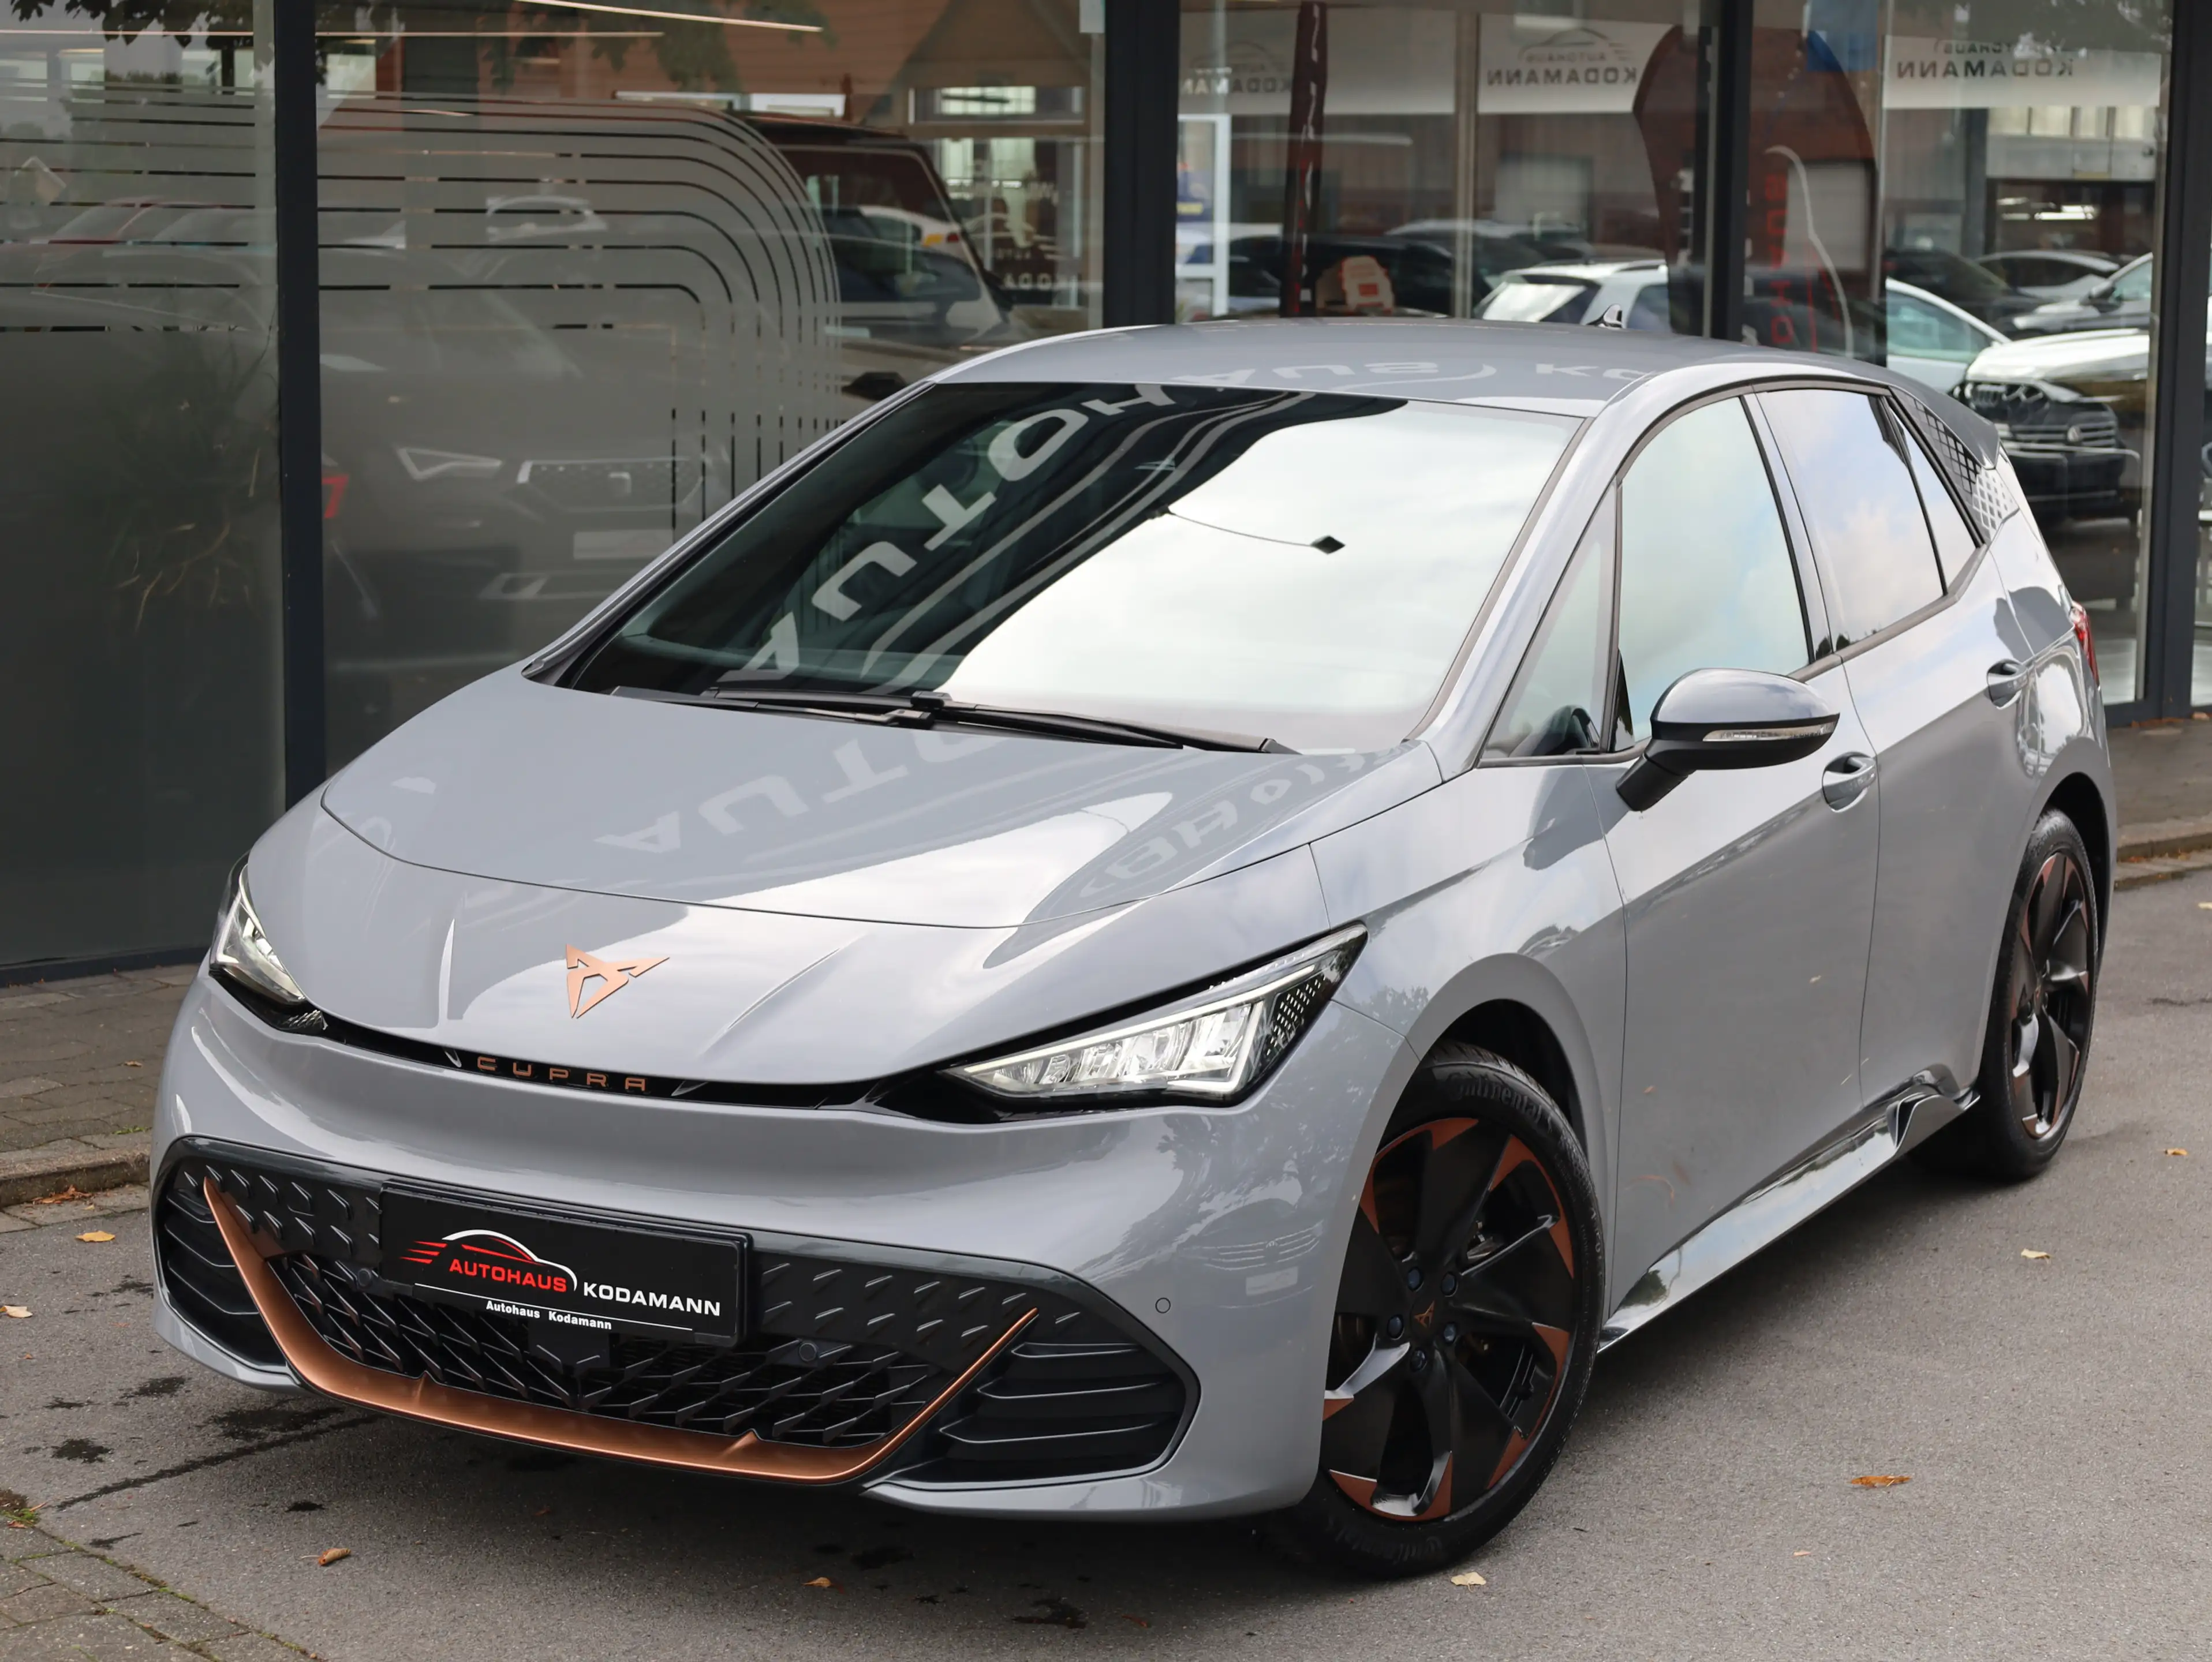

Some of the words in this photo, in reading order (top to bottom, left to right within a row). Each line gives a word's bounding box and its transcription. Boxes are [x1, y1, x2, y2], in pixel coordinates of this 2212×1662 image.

[477, 1055, 646, 1092] CUPRA
[449, 1258, 567, 1293] AUTOHAUS
[582, 1281, 721, 1317] KODAMANN
[485, 1300, 541, 1319] Autohaus
[548, 1310, 612, 1330] Kodamann
